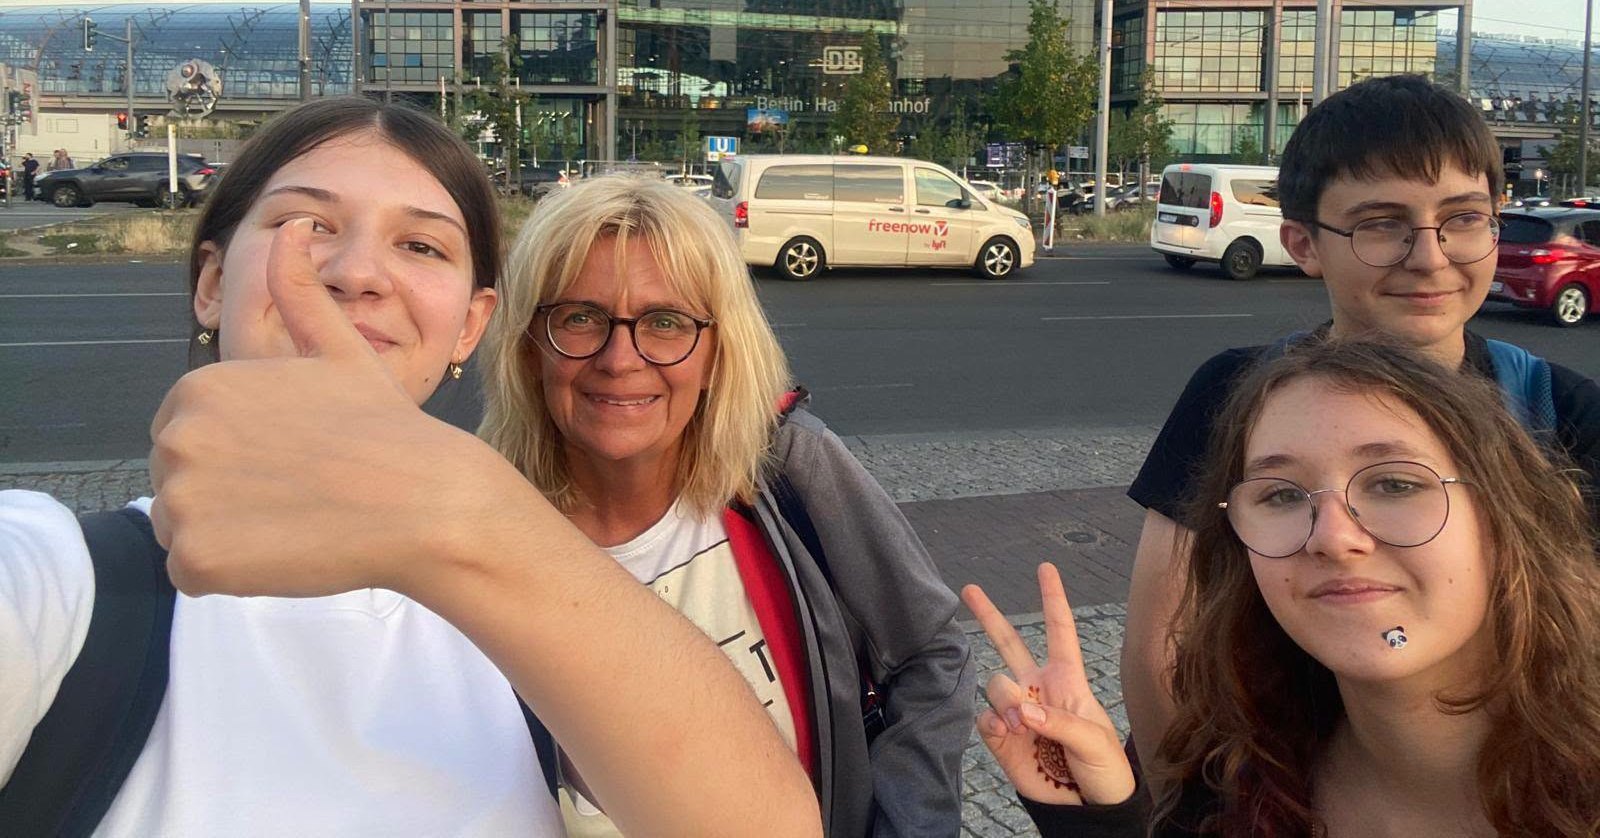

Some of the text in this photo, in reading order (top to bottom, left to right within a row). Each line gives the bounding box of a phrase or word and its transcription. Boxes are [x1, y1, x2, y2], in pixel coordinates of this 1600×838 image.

[829, 50, 858, 70] DB
[717, 138, 728, 152] U
[868, 219, 931, 234] freenow
